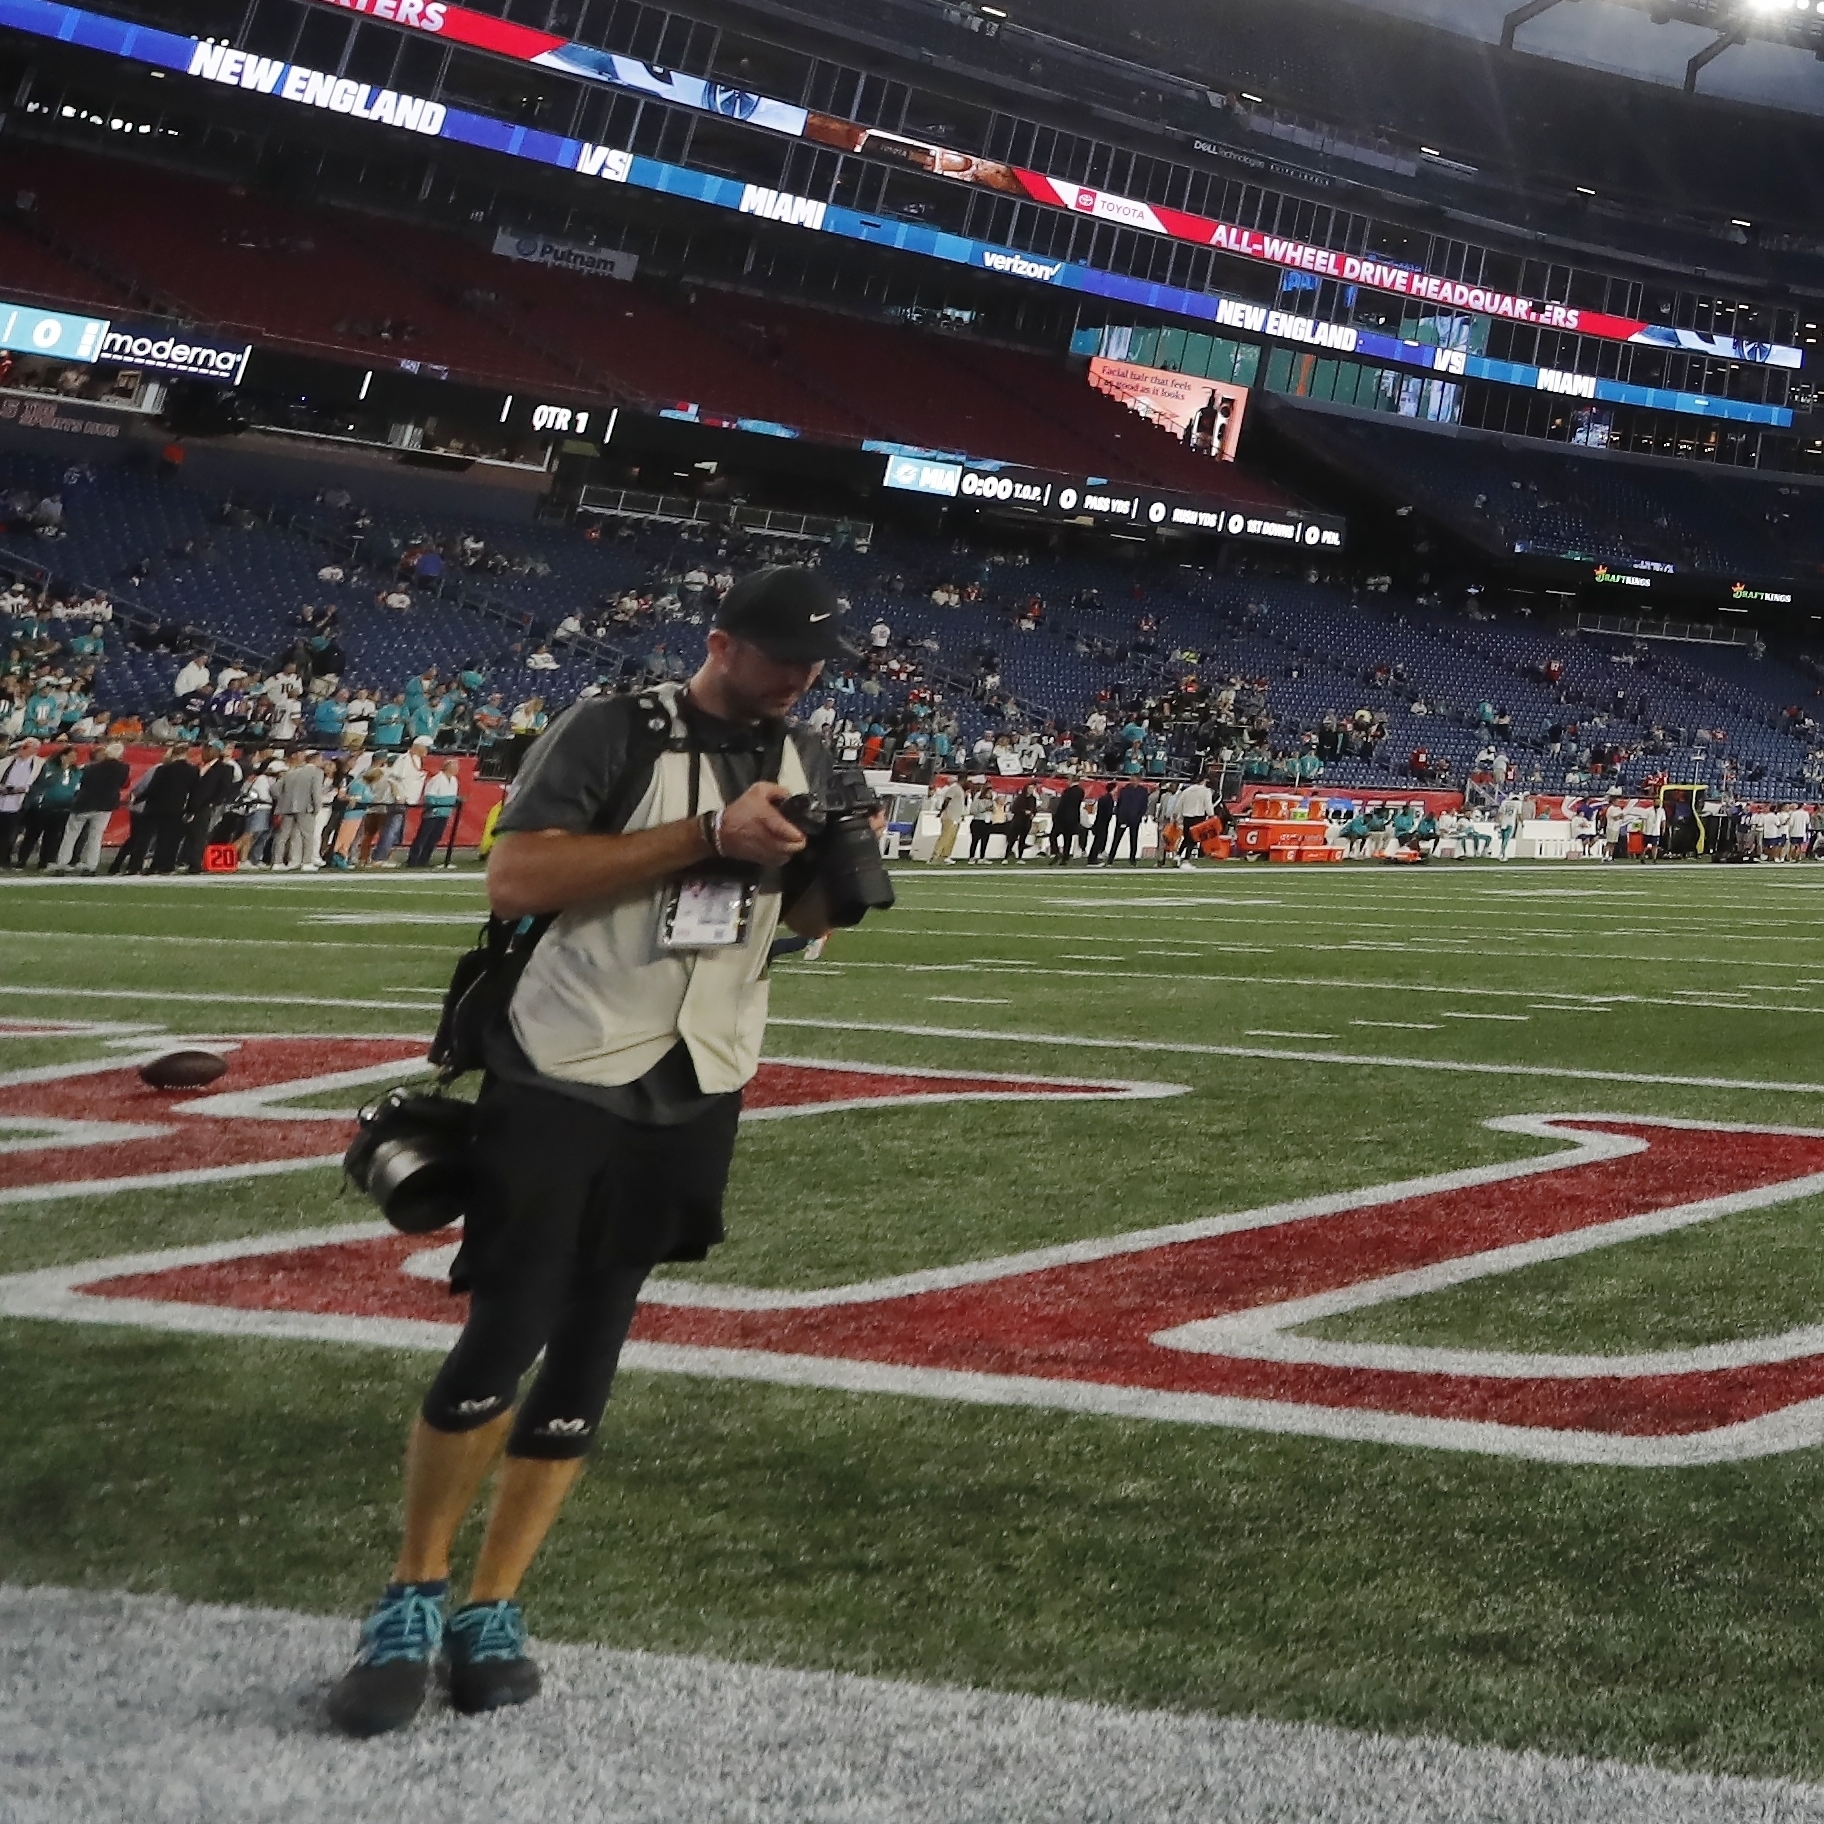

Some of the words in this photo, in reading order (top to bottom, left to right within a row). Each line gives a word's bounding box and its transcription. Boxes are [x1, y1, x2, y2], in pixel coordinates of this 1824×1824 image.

[188, 40, 282, 93] NEW
[281, 68, 448, 137] ENGLAND
[582, 142, 633, 180] VS
[739, 182, 826, 230] MIAMI
[1100, 196, 1147, 222] TOYOTA
[540, 242, 616, 272] Putnam
[983, 249, 1050, 280] verizon
[1210, 224, 1341, 276] ALL-WHEEL
[1343, 258, 1409, 294] DRIVE
[32, 318, 61, 347] 0
[102, 332, 238, 372] moderna
[1215, 297, 1268, 337] NEW
[1265, 310, 1358, 354] ENGLAND
[1433, 347, 1467, 375] VS
[1537, 367, 1597, 399] MIAMI
[1102, 365, 1129, 378] Facial
[1129, 370, 1150, 383] hair
[1150, 375, 1169, 385] that
[1170, 378, 1192, 391] feels
[1115, 381, 1140, 393] good
[1160, 388, 1186, 401] looks
[533, 402, 569, 431] QTR
[575, 410, 589, 433] 1
[919, 465, 955, 491] MIA
[962, 471, 1013, 501] 0:00
[1014, 481, 1042, 503] T.O.P.
[1059, 487, 1077, 509] 0
[1084, 494, 1109, 513] PASS
[1108, 498, 1130, 515] YDS
[1148, 500, 1165, 523] 0
[1172, 506, 1199, 526] RUSH
[1199, 510, 1217, 529] YDS
[1228, 513, 1244, 535] 0
[1246, 517, 1263, 536] 1ST
[1262, 519, 1294, 541] DOWNS
[1304, 524, 1320, 546] 0
[1321, 528, 1341, 547] PEN.
[1594, 570, 1651, 588] DRAFTKINGS
[1732, 587, 1792, 604] DRAFTKINGS
[1245, 830, 1259, 845] G
[209, 847, 235, 866] 20
